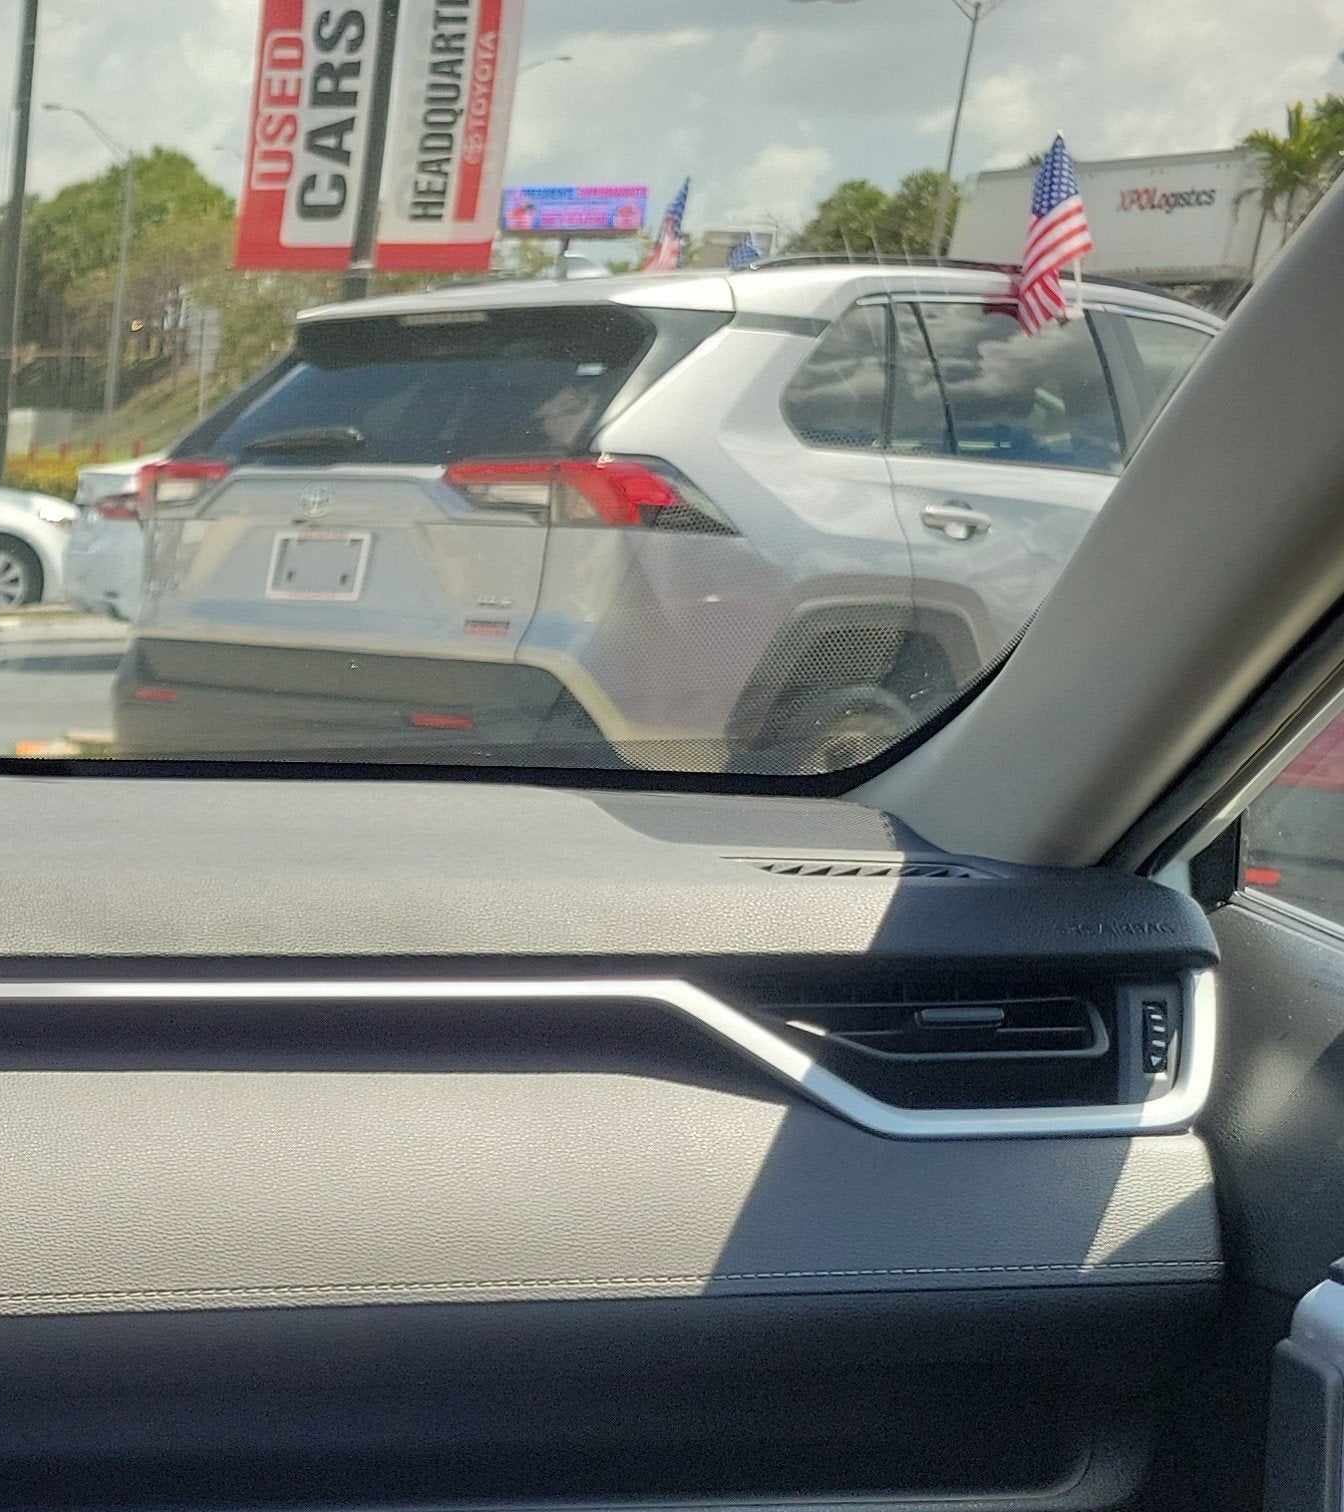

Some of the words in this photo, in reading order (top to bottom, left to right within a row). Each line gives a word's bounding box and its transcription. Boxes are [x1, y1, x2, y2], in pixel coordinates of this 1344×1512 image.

[254, 30, 305, 190] USED
[296, 9, 366, 221] CARS
[464, 31, 499, 135] TOYOTA
